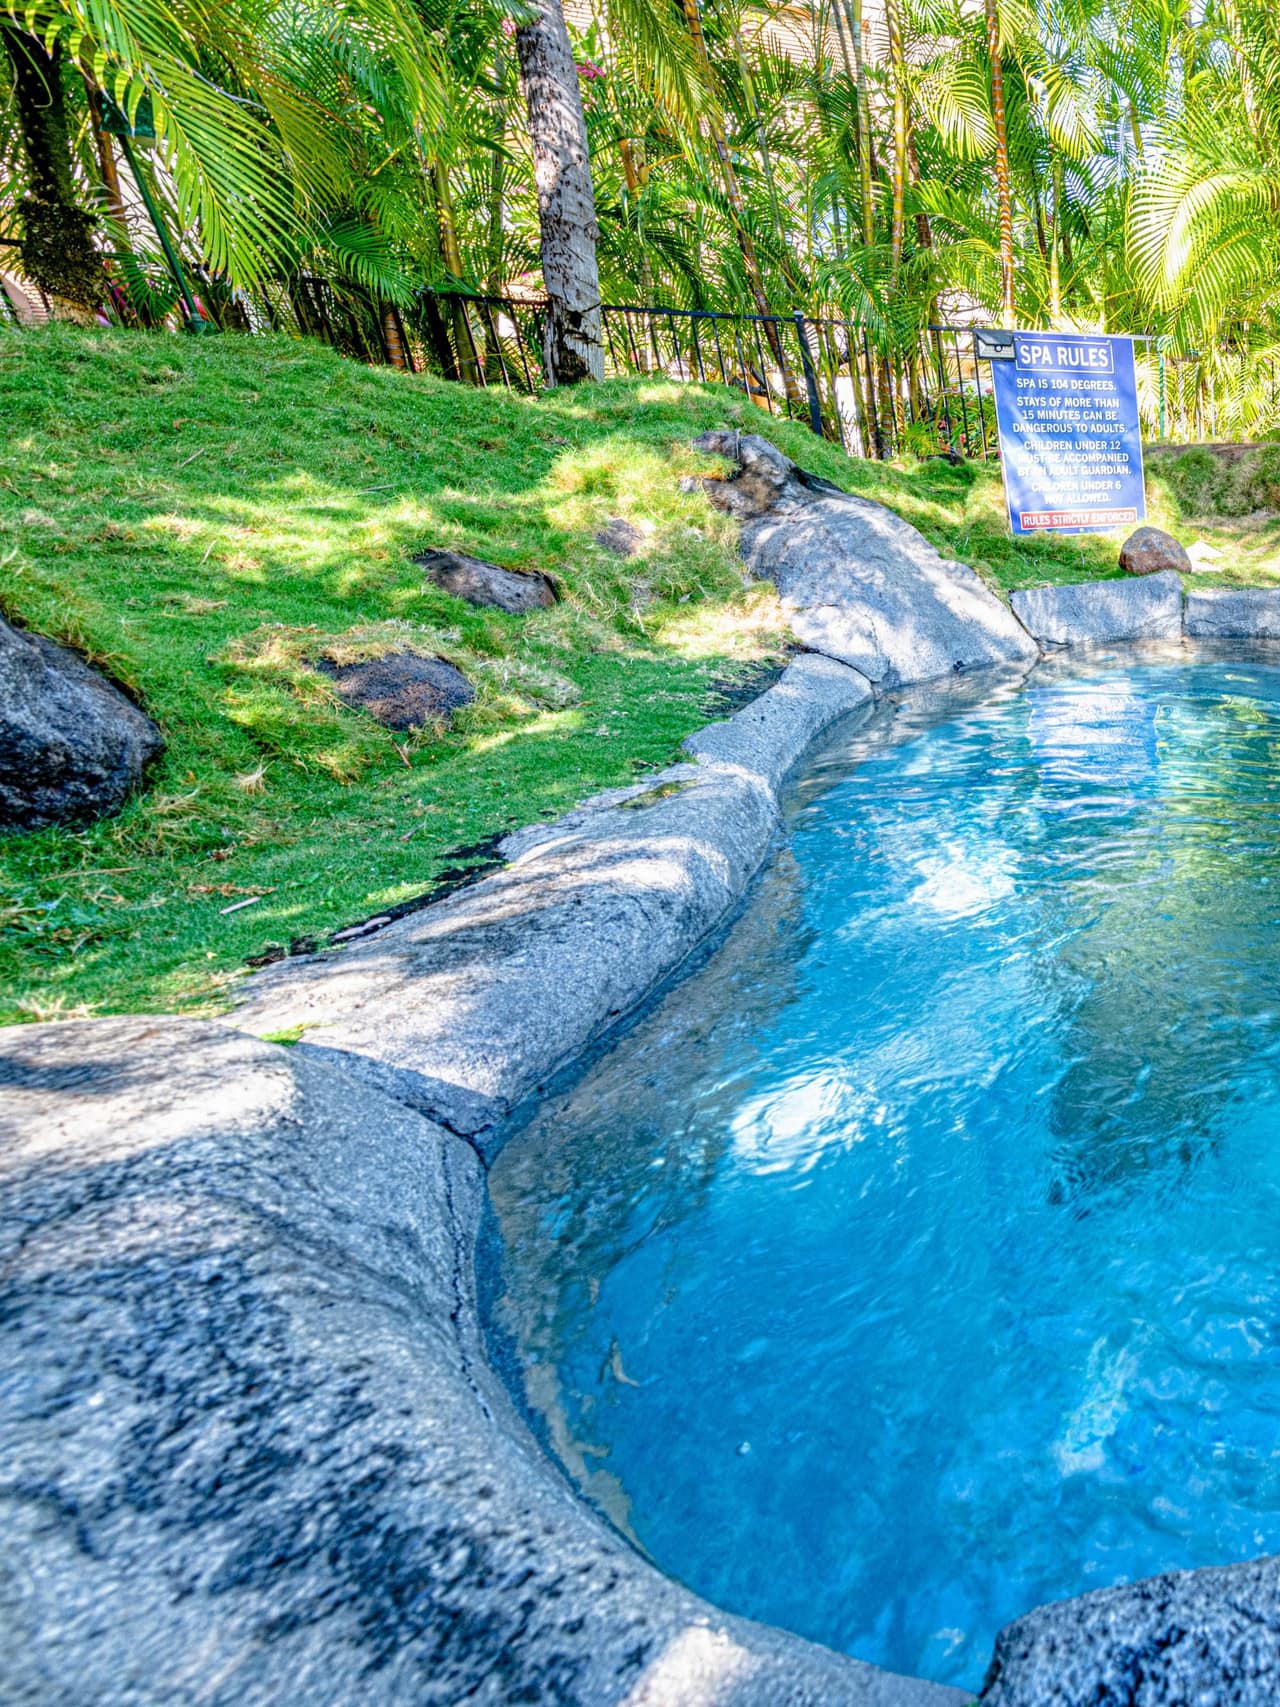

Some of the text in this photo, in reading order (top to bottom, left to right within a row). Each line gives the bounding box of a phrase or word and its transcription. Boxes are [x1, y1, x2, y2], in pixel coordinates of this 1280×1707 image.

[1020, 345, 1108, 367] SPA RULES
[1016, 378, 1116, 391] SPA IS 104 DEGREES.
[1016, 397, 1120, 408] STAYS OF MORE THAN
[1022, 411, 1118, 420] 15 MINUTES CAN BE
[1012, 423, 1128, 433] DANGEROUS TO ADULTS.
[1024, 440, 1121, 450] CHILDREN UNDER 12
[1017, 453, 1045, 464] MUST
[1063, 453, 1129, 463] ACCOMPANIED
[1050, 465, 1078, 477] ADULT
[1081, 465, 1131, 475] GUARDIAN.
[1032, 480, 1121, 492] CHILDREN UNDER 6
[1066, 493, 1112, 504] ALLOWED.
[1023, 511, 1134, 526] RULES STRICTLY ENFORCED
